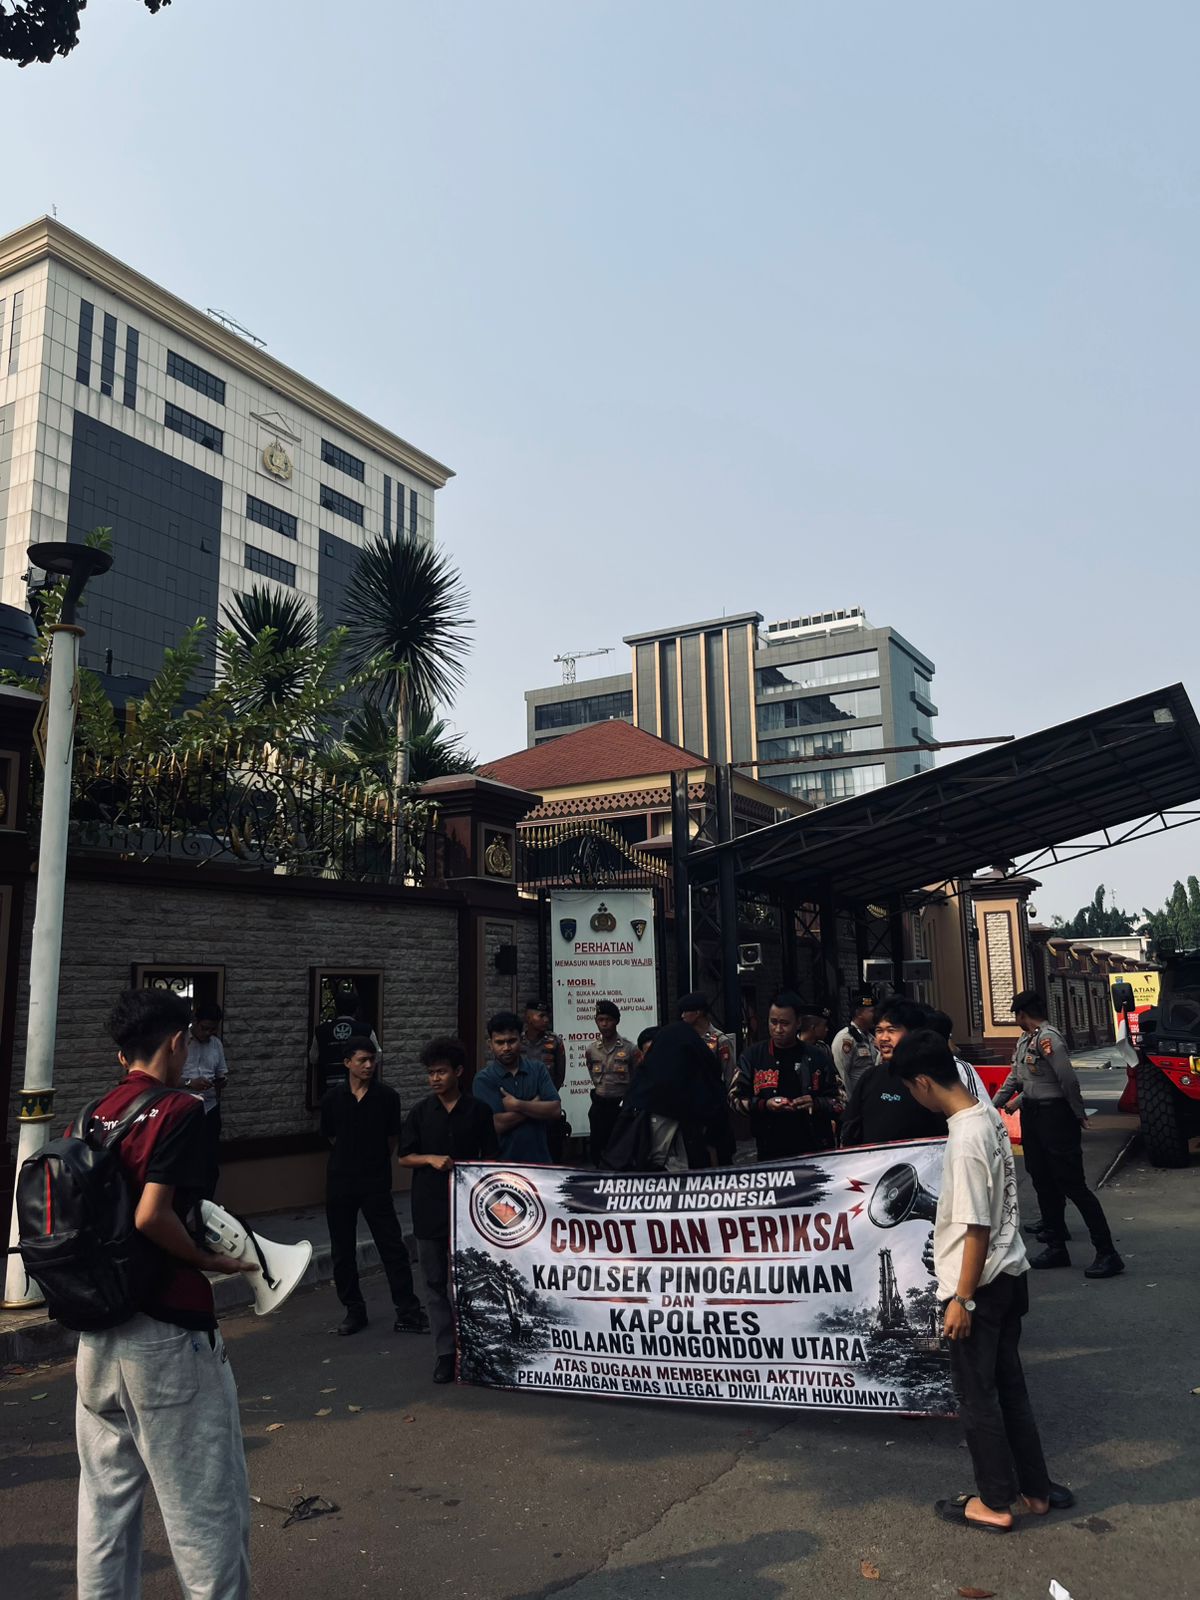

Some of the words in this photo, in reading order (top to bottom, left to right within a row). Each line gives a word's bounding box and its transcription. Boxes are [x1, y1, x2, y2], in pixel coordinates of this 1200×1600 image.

[574, 942, 634, 953] PERHATIAN
[631, 958, 653, 966] WAJIB
[594, 1177, 683, 1194] JARINGAN
[686, 1170, 796, 1190] MAHASISWA
[606, 1195, 675, 1211] HUKUM
[678, 1190, 776, 1209] INDONESIA
[550, 1218, 638, 1254] COPOT
[646, 1217, 712, 1254] DAN
[718, 1212, 854, 1254] PERIKSA
[532, 1264, 652, 1291] KAPOLSEK
[660, 1263, 853, 1294] PINOGALUMAN
[661, 1295, 695, 1308] DAN
[610, 1308, 760, 1336] KAPOLRES
[551, 1328, 635, 1355] BOLAANG
[641, 1334, 784, 1360] MONGONDOW
[791, 1336, 866, 1362] UTARA
[554, 1358, 587, 1373] ATAS
[591, 1363, 652, 1379] DUGAAN
[656, 1366, 760, 1383] MEMBEKINGI
[766, 1370, 856, 1388] AKTIVITAS
[518, 1370, 619, 1391] PENAMBANGAN
[623, 1380, 661, 1394] EMAS
[665, 1382, 723, 1398] ILLEGAL
[728, 1384, 807, 1402] DIWILAYAH
[812, 1388, 900, 1407] HUKUMNYA
